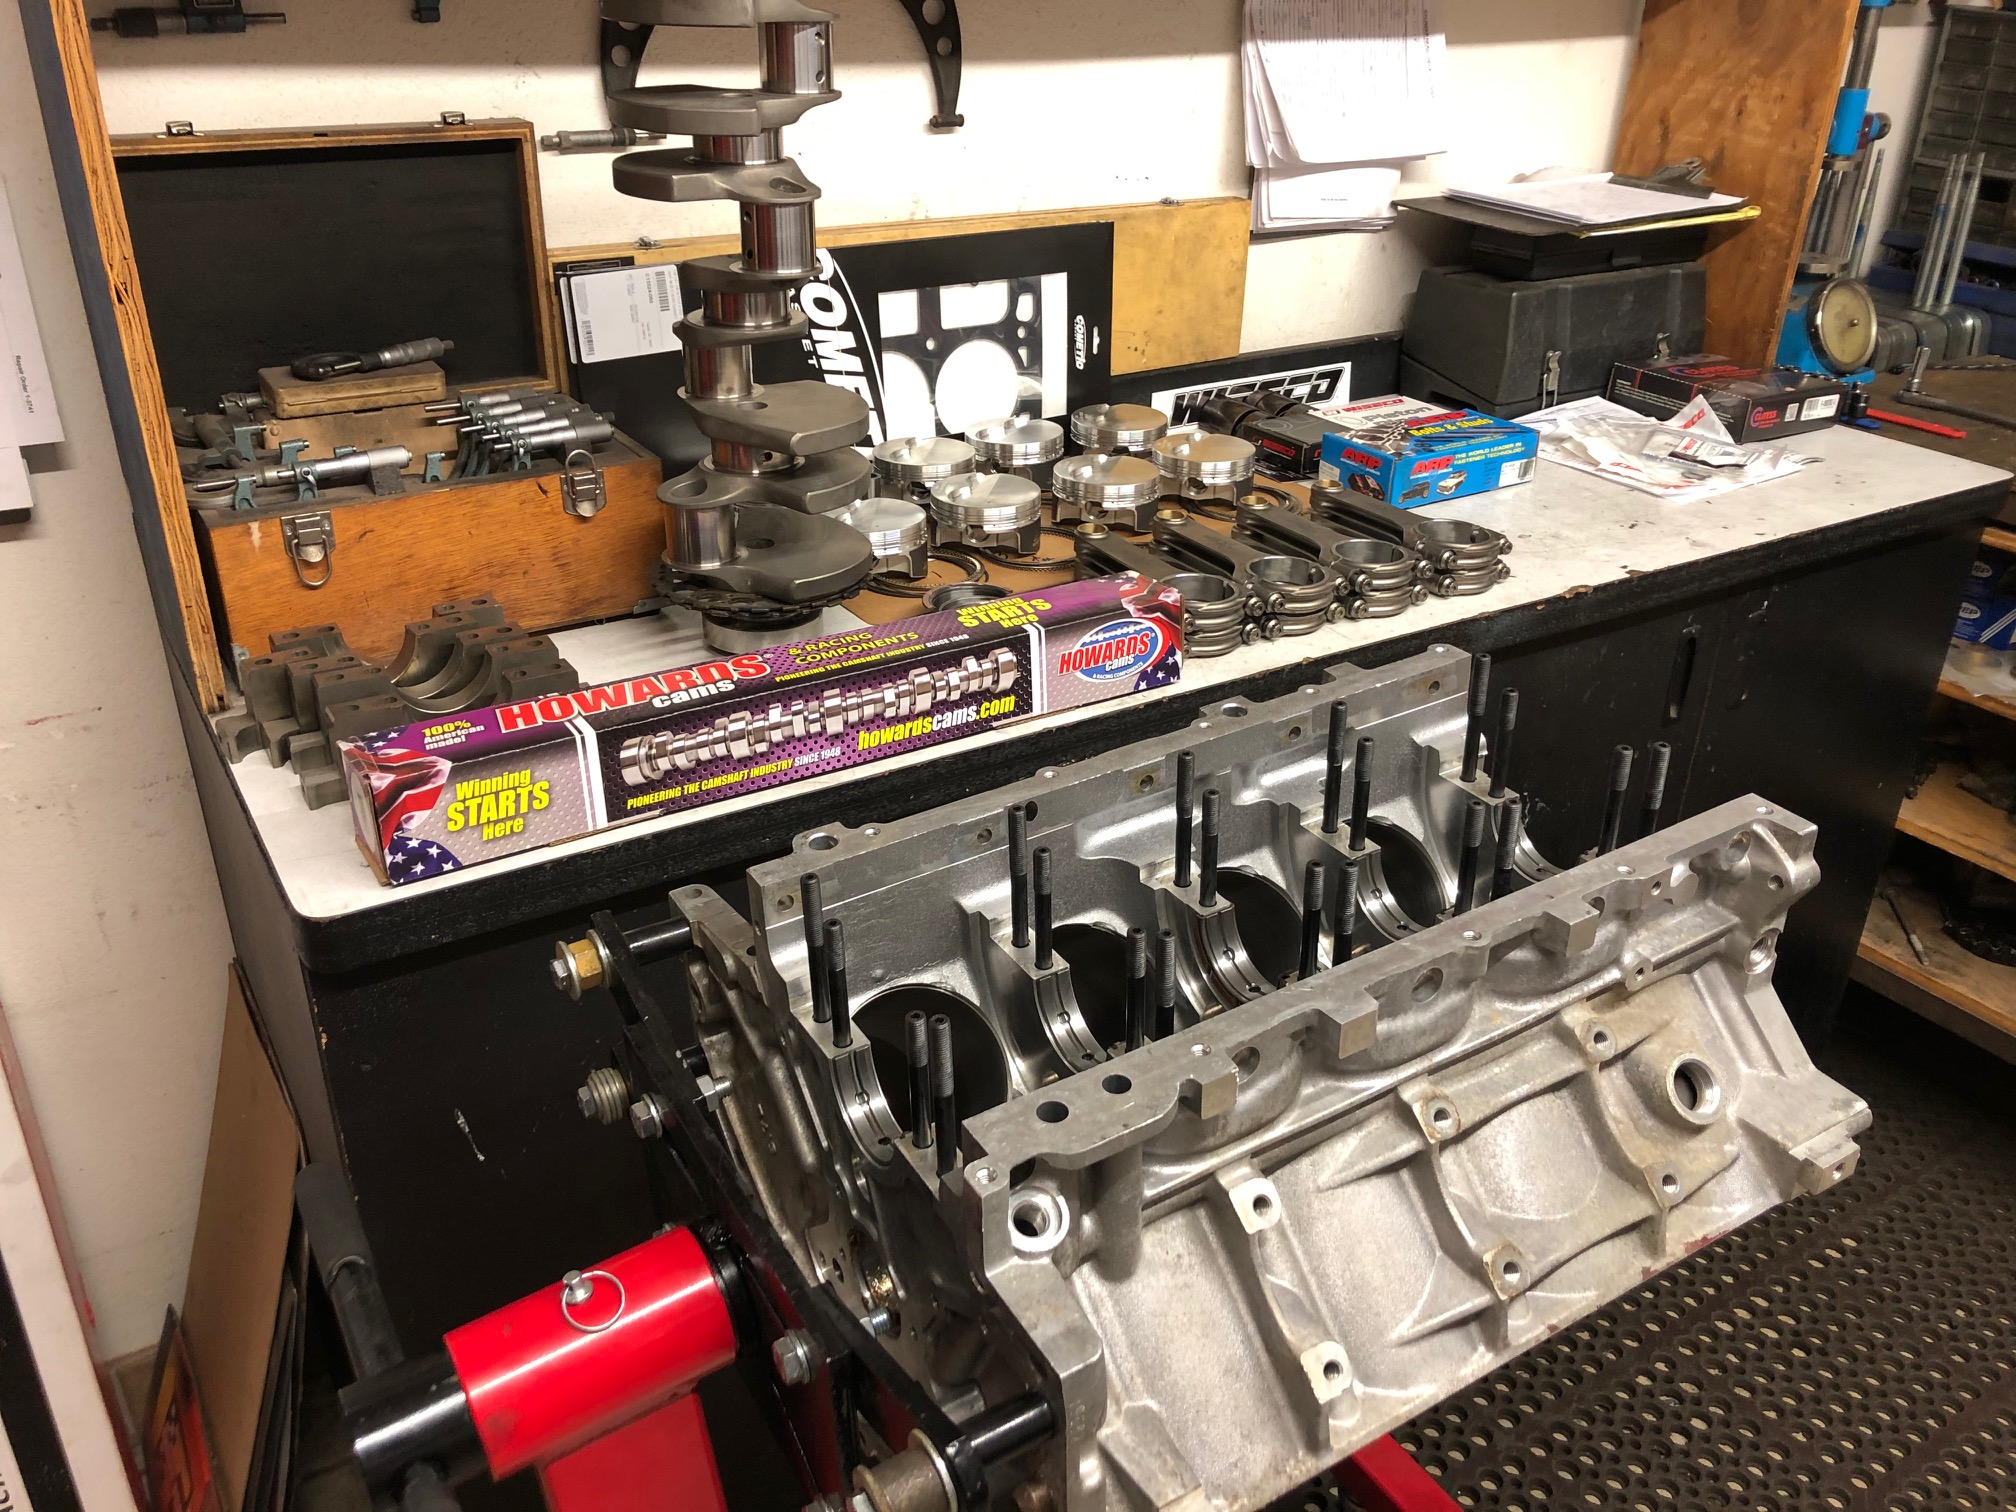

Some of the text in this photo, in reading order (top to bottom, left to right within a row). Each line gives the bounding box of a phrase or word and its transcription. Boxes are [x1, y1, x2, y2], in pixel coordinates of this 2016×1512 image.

[16, 355, 24, 375] Repair
[20, 376, 28, 393] Order
[1408, 426, 1445, 436] Bolts
[1456, 418, 1494, 428] Studs
[1341, 447, 1383, 469] ARP
[1454, 447, 1526, 465] FASTENER TECHNOLOGY
[1468, 448, 1490, 456] WORLD
[1491, 443, 1515, 452] LEADER
[1410, 455, 1454, 475] ARP
[956, 597, 1026, 616] Winning
[957, 598, 1052, 628] STARTS
[999, 613, 1040, 630] Here
[788, 632, 873, 655] & RACING
[795, 632, 920, 664] COMPONENTS
[1058, 631, 1151, 676] HOWARDS
[774, 667, 826, 683] PIONEERING
[826, 661, 842, 671] THE
[843, 652, 886, 669] CAMSHAFT
[886, 644, 926, 659] INDUSTRY
[925, 638, 950, 649] SINCE
[1105, 654, 1135, 672] cams
[1113, 661, 1144, 678] COMPONENTS
[494, 654, 771, 734] HOWARDS
[652, 680, 735, 708] cams
[421, 719, 471, 737] 100%
[424, 725, 485, 744] American
[858, 694, 1016, 752] howardscams.com
[455, 768, 532, 800] Winning
[627, 746, 841, 810] PIONEERING THE CAMSHAFT INDUSTRY SINCE 1948
[446, 780, 551, 832] STARTS
[482, 816, 524, 841] Here
